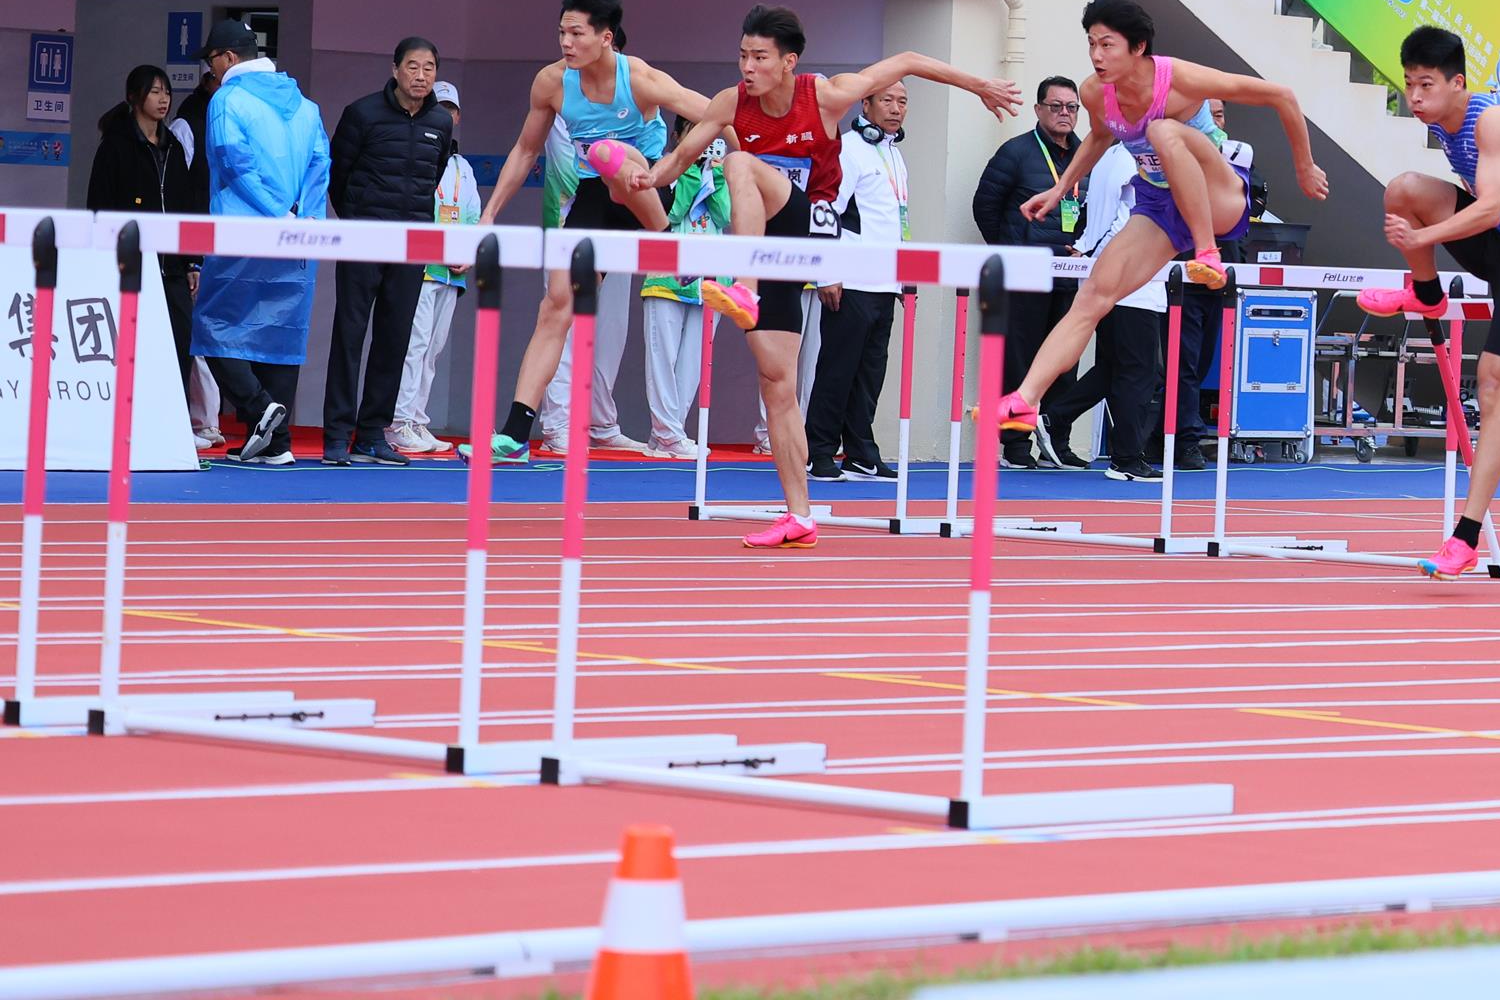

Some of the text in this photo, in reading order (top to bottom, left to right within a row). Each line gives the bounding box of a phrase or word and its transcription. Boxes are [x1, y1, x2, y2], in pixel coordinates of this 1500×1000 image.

[33, 100, 64, 112] 卫生间
[785, 131, 814, 144] 新疆
[813, 205, 836, 228] 8
